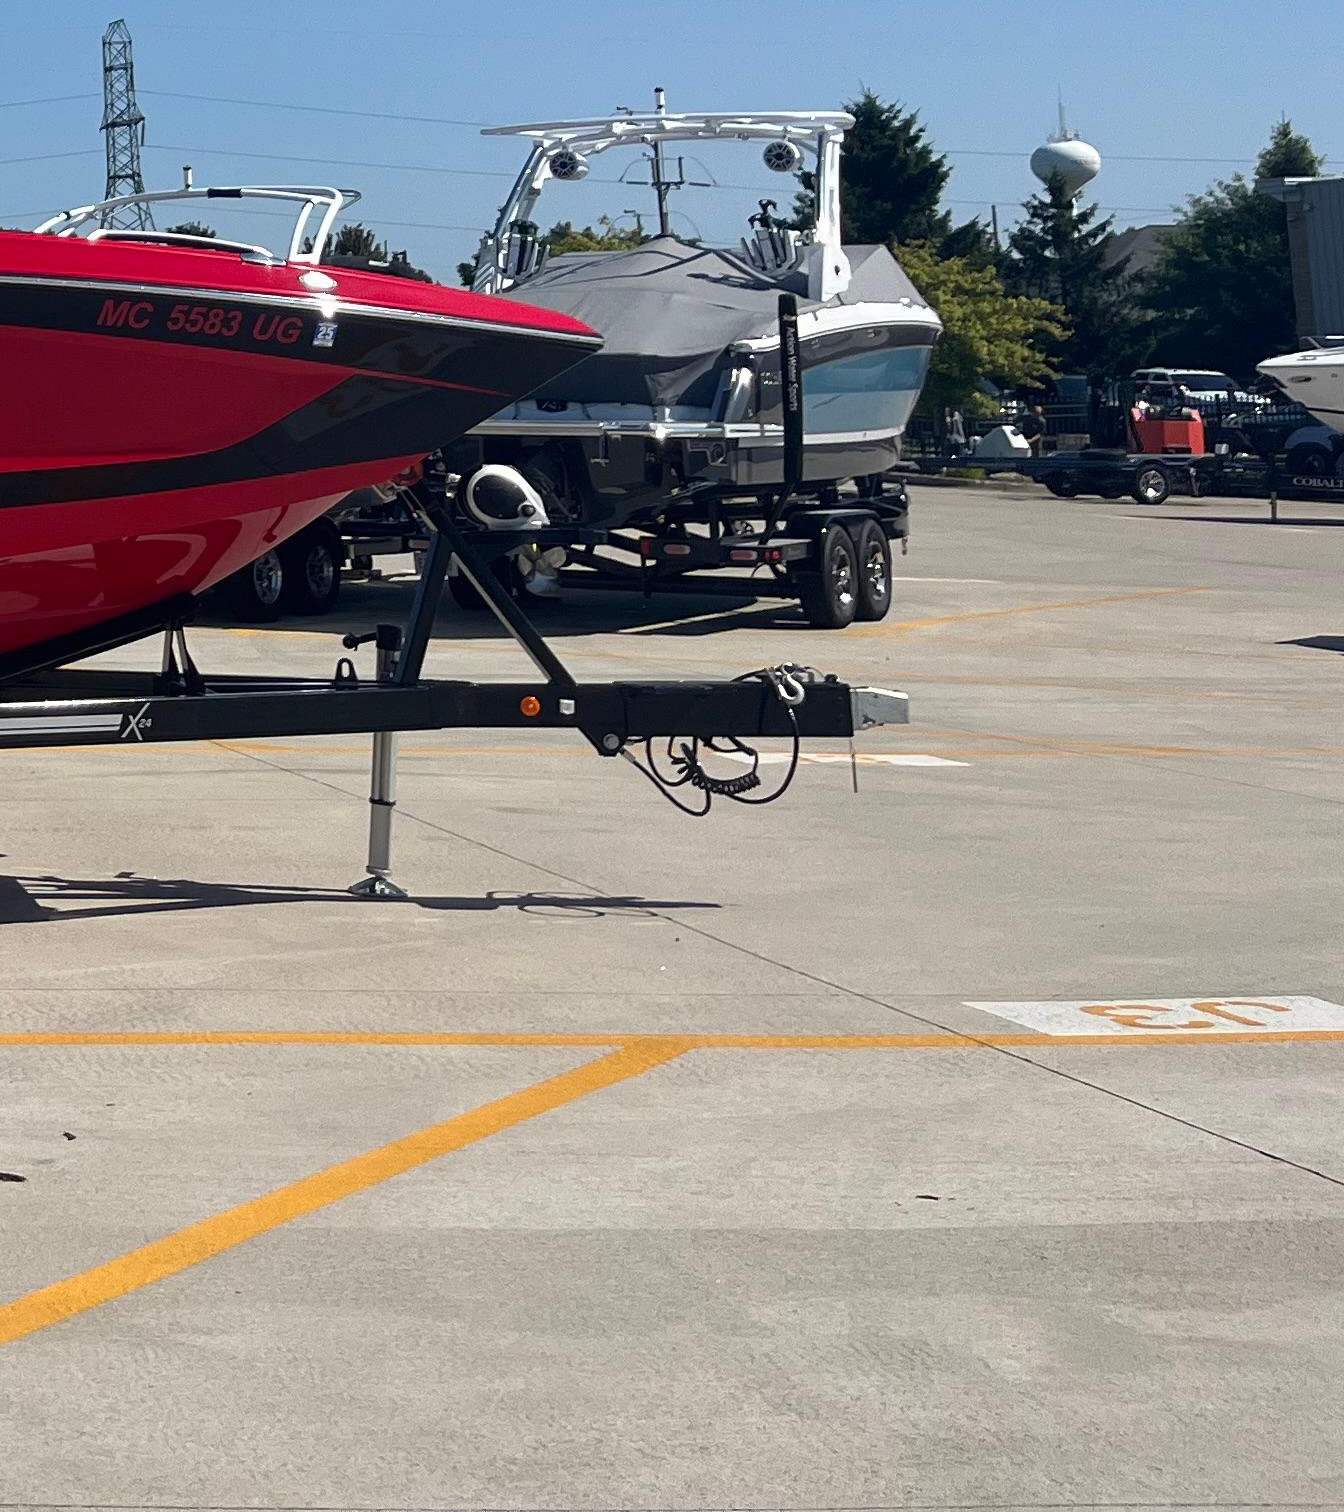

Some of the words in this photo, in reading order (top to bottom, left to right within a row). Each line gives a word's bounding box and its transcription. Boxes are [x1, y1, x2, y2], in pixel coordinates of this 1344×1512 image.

[96, 298, 154, 329] MC
[166, 303, 244, 337] 5583
[252, 312, 304, 345] UG
[317, 326, 334, 340] 25
[786, 327, 795, 355] Action
[787, 356, 797, 382] Water
[789, 383, 798, 410] Sports
[1293, 477, 1344, 488] COBALT
[121, 702, 153, 741] X24
[1079, 1000, 1293, 1030] J3
